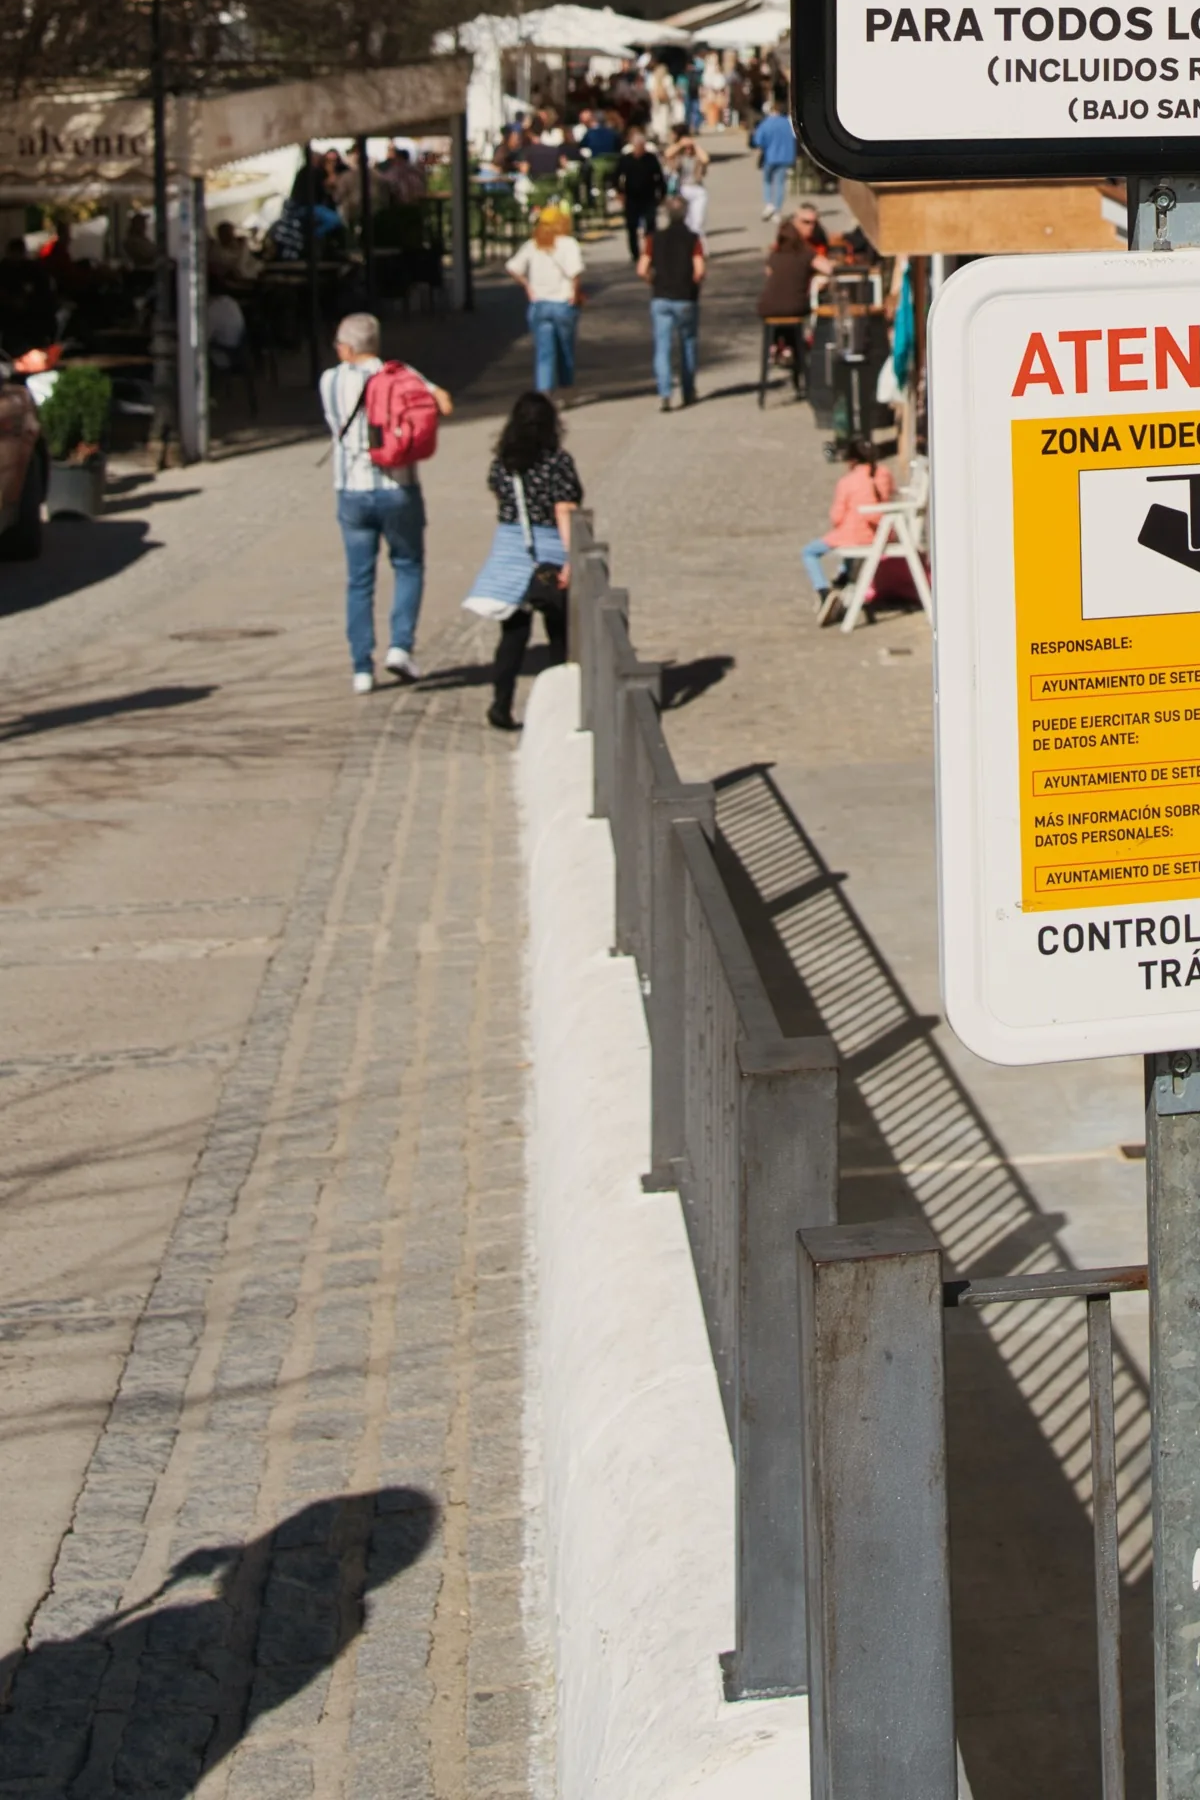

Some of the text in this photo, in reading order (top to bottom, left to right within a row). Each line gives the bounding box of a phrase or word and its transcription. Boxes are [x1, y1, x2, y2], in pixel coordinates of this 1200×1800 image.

[866, 7, 984, 43] PARA
[994, 6, 1153, 42] TODOS
[987, 55, 1179, 87] (INCLUIDOS
[1068, 97, 1149, 123] (BAJO
[1041, 425, 1122, 455] ZONA
[1030, 636, 1133, 655] RESPONSABLE:
[1041, 673, 1145, 693] AYUNTAMIENTO
[1148, 672, 1166, 686] DE
[1032, 717, 1077, 732] PUEDE
[1080, 711, 1151, 729] EJERCITAR
[1154, 709, 1181, 724] SUS
[1032, 731, 1140, 752] DE DATOS ANTE:
[1043, 769, 1148, 789] AYUNTAMIENTO
[1150, 767, 1169, 781] DE
[1034, 814, 1065, 829] MÁS
[1067, 806, 1161, 826] INFORMACIÓN
[1035, 824, 1174, 848] DATOS PERSONALES:
[1045, 864, 1149, 886] AYUNTAMIENTO
[1152, 863, 1171, 877] DE
